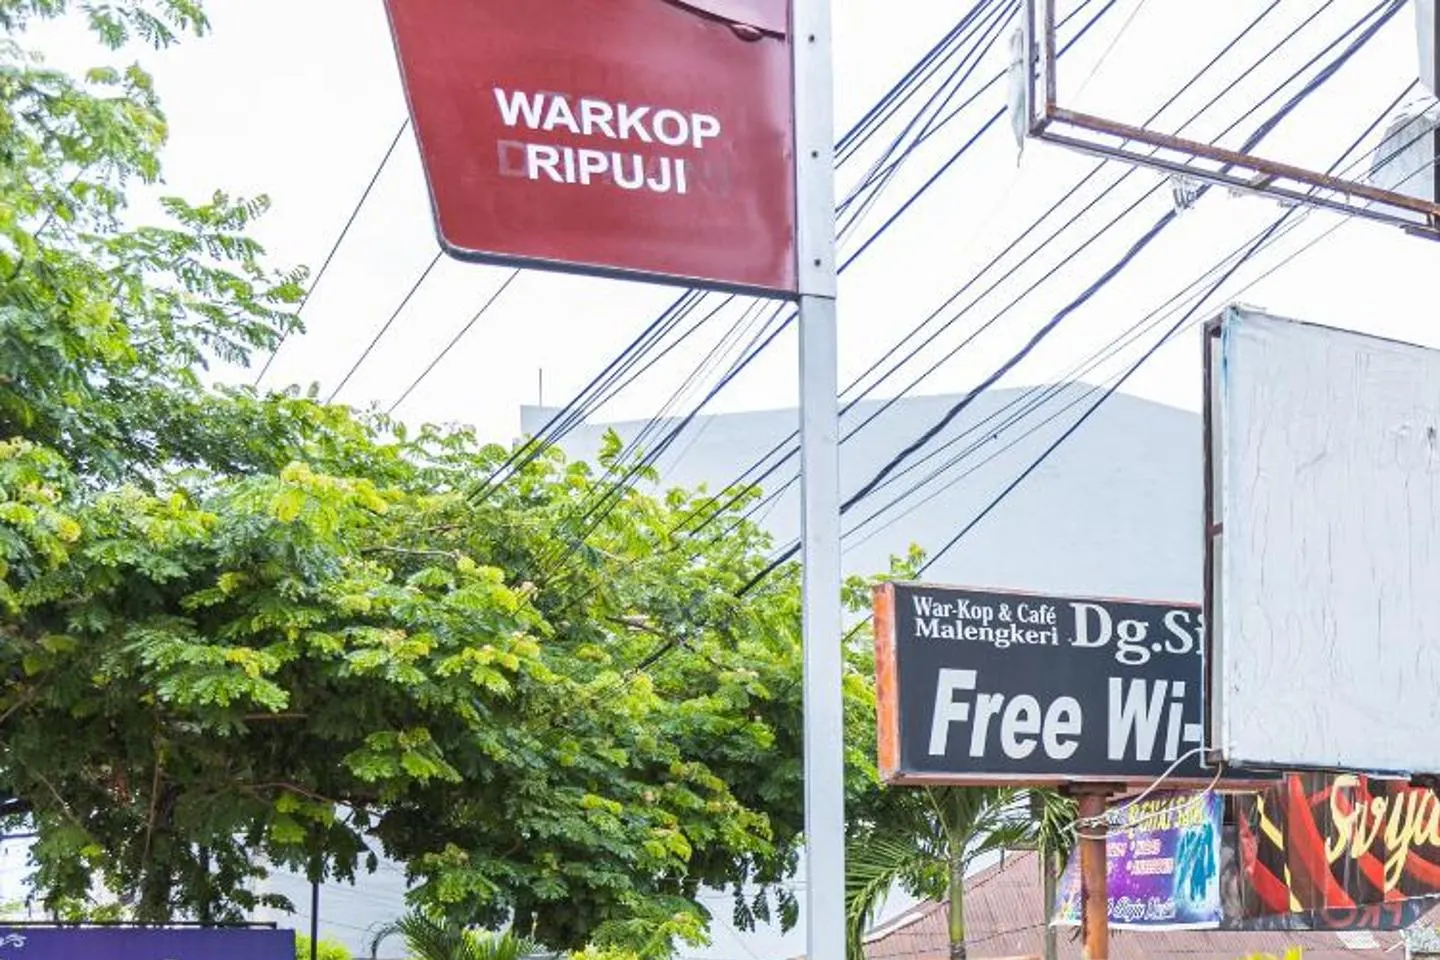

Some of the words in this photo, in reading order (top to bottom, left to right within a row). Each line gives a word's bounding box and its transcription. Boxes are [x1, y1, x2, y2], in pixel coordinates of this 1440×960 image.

[493, 87, 721, 149] WARKOP
[526, 143, 687, 194] RIPUJI
[913, 595, 994, 625] War-Kop
[998, 604, 1012, 622] &
[1017, 602, 1058, 625] Café
[915, 617, 1059, 648] Malengkeri
[928, 668, 1083, 760] Free
